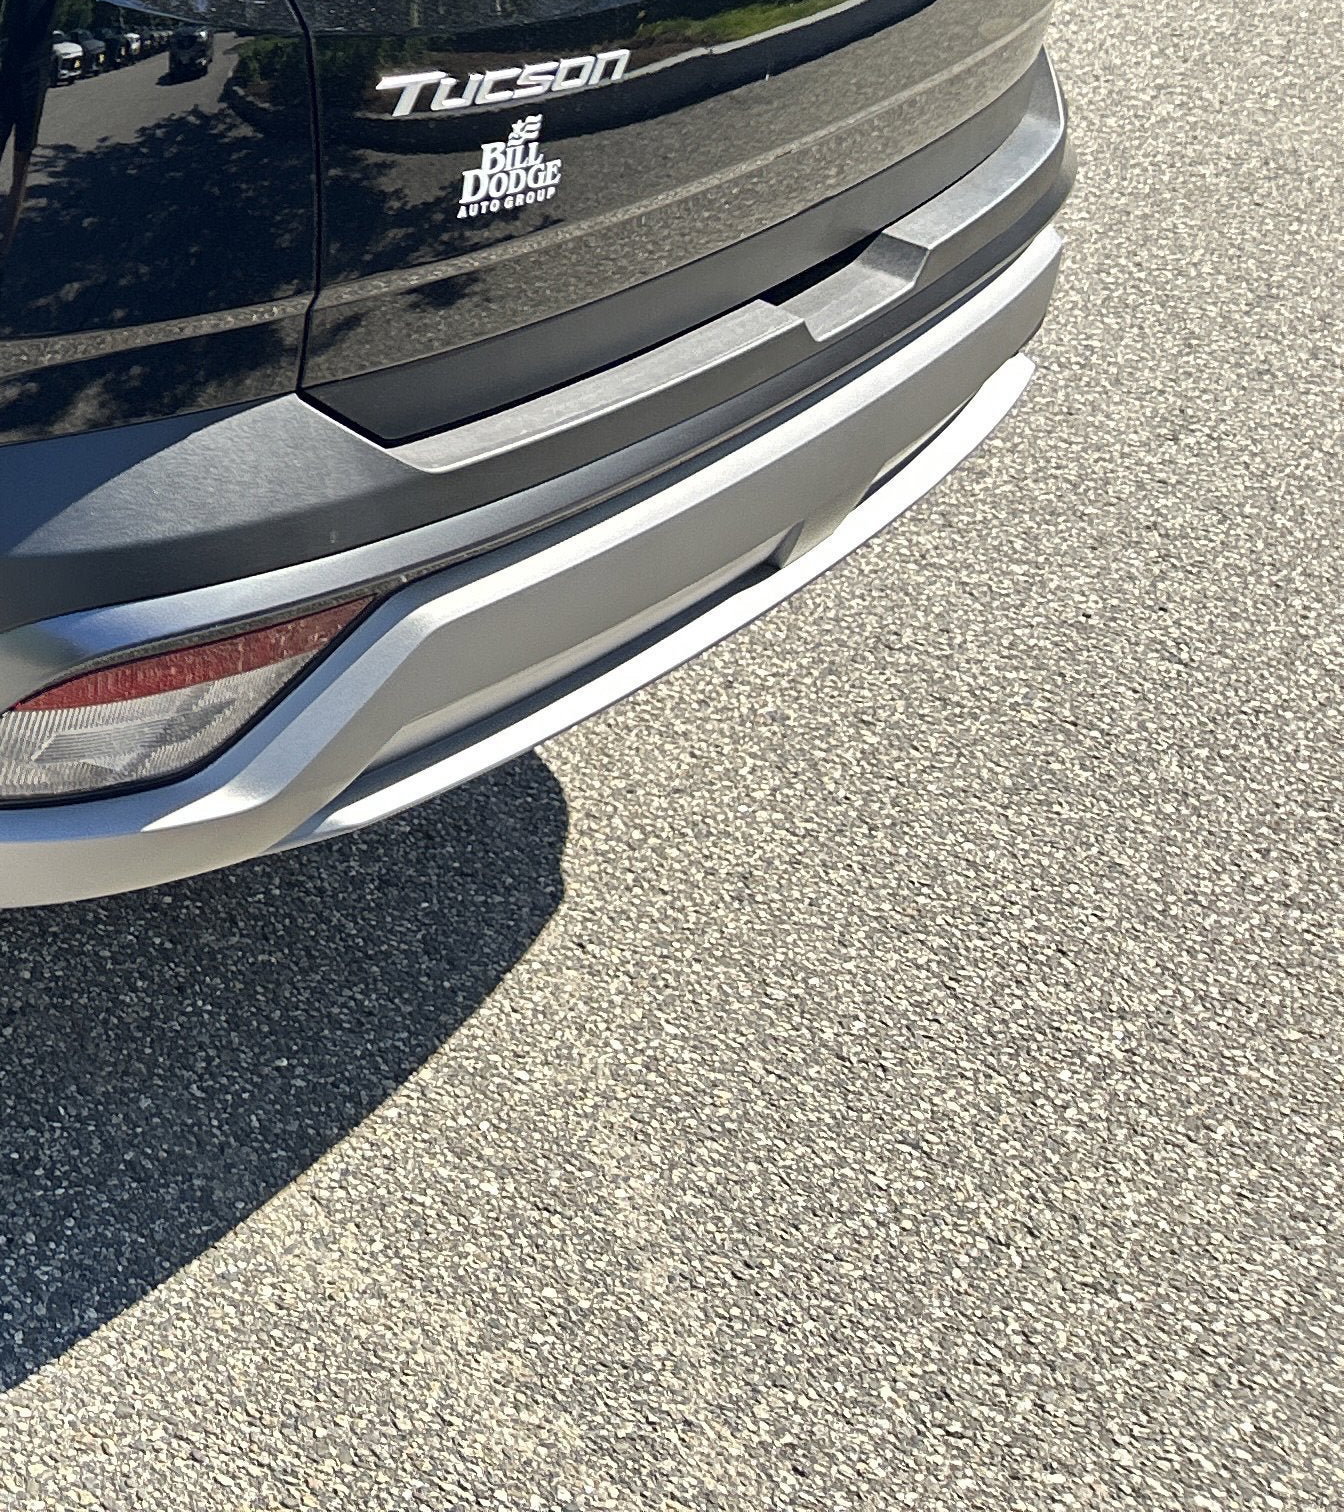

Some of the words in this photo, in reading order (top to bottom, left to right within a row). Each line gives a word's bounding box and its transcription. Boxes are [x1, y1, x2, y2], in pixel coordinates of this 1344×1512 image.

[375, 48, 631, 117] TUCSON
[480, 141, 545, 176] BILL
[458, 158, 562, 205] DODGE
[456, 197, 502, 219] AUTO
[503, 186, 556, 210] GROUP
